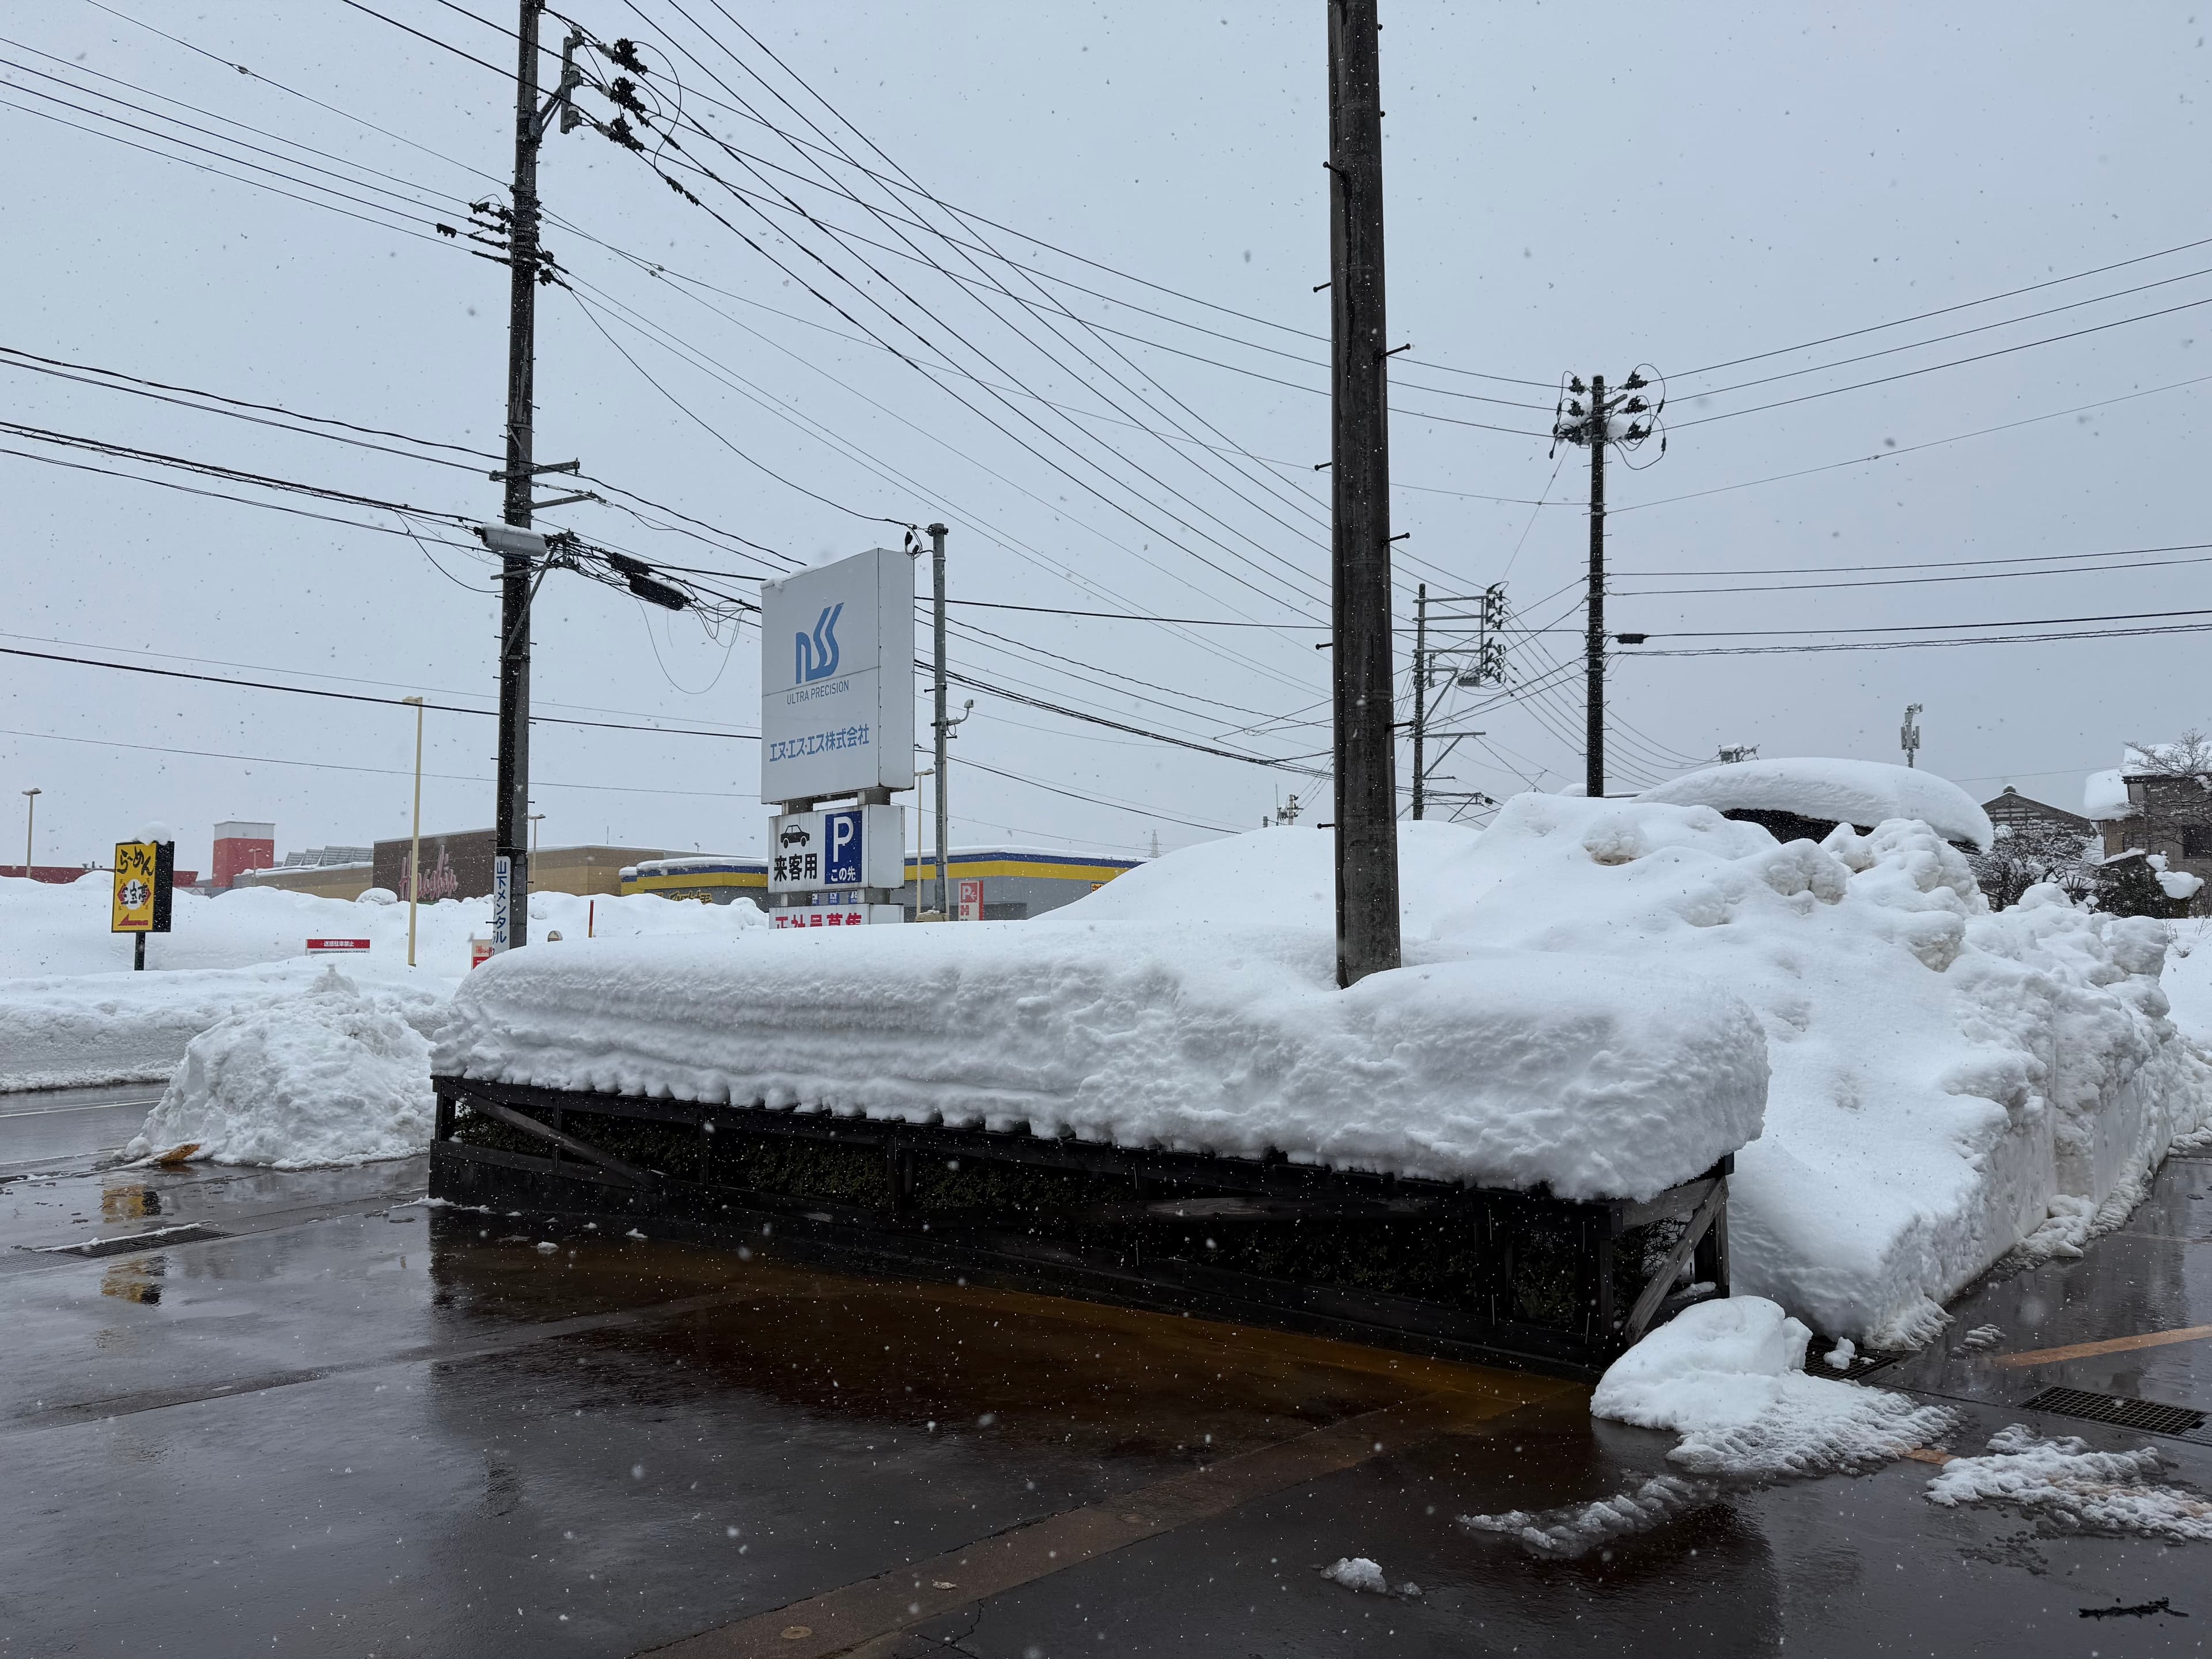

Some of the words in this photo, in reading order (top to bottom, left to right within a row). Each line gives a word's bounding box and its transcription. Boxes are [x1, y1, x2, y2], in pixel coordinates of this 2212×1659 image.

[787, 690, 809, 705] ULTRA
[811, 680, 849, 699] PRECISION
[769, 723, 869, 762] エヌ・エス・エス株式会社
[833, 816, 854, 862] P
[774, 853, 817, 882] 来客用
[831, 866, 856, 882] この先
[496, 860, 507, 944] 山下メンタル
[962, 885, 972, 900] P
